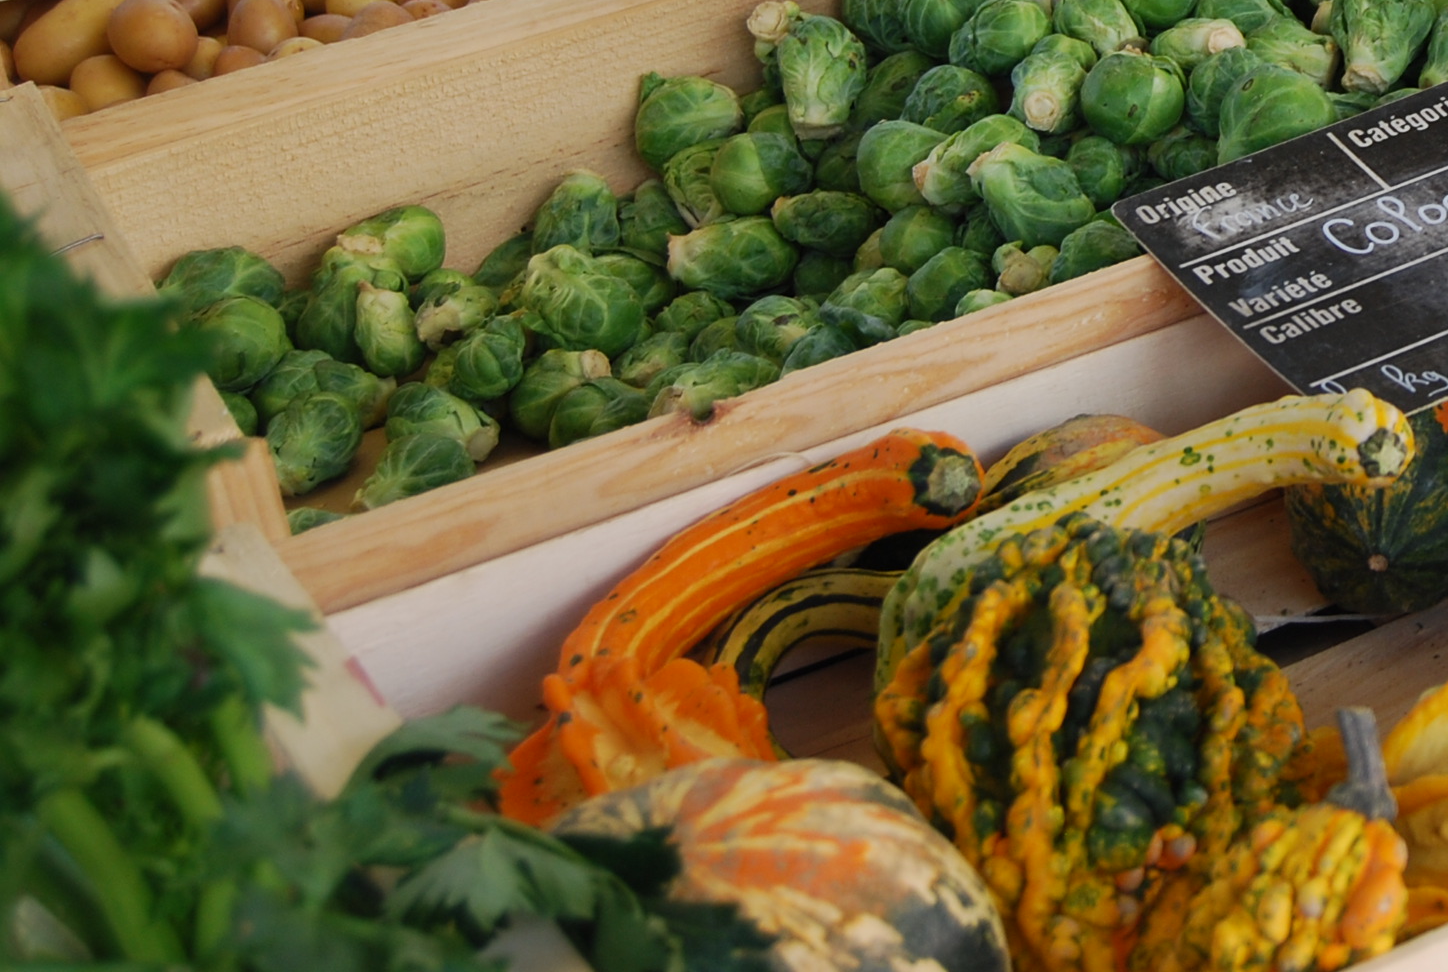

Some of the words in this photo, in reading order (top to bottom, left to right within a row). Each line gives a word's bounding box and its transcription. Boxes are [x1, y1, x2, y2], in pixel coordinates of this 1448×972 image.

[1135, 182, 1237, 225] Origine
[1191, 193, 1314, 241] France
[1193, 236, 1300, 285] Produit
[1228, 269, 1334, 319] Variété
[1258, 295, 1362, 346] Calibre
